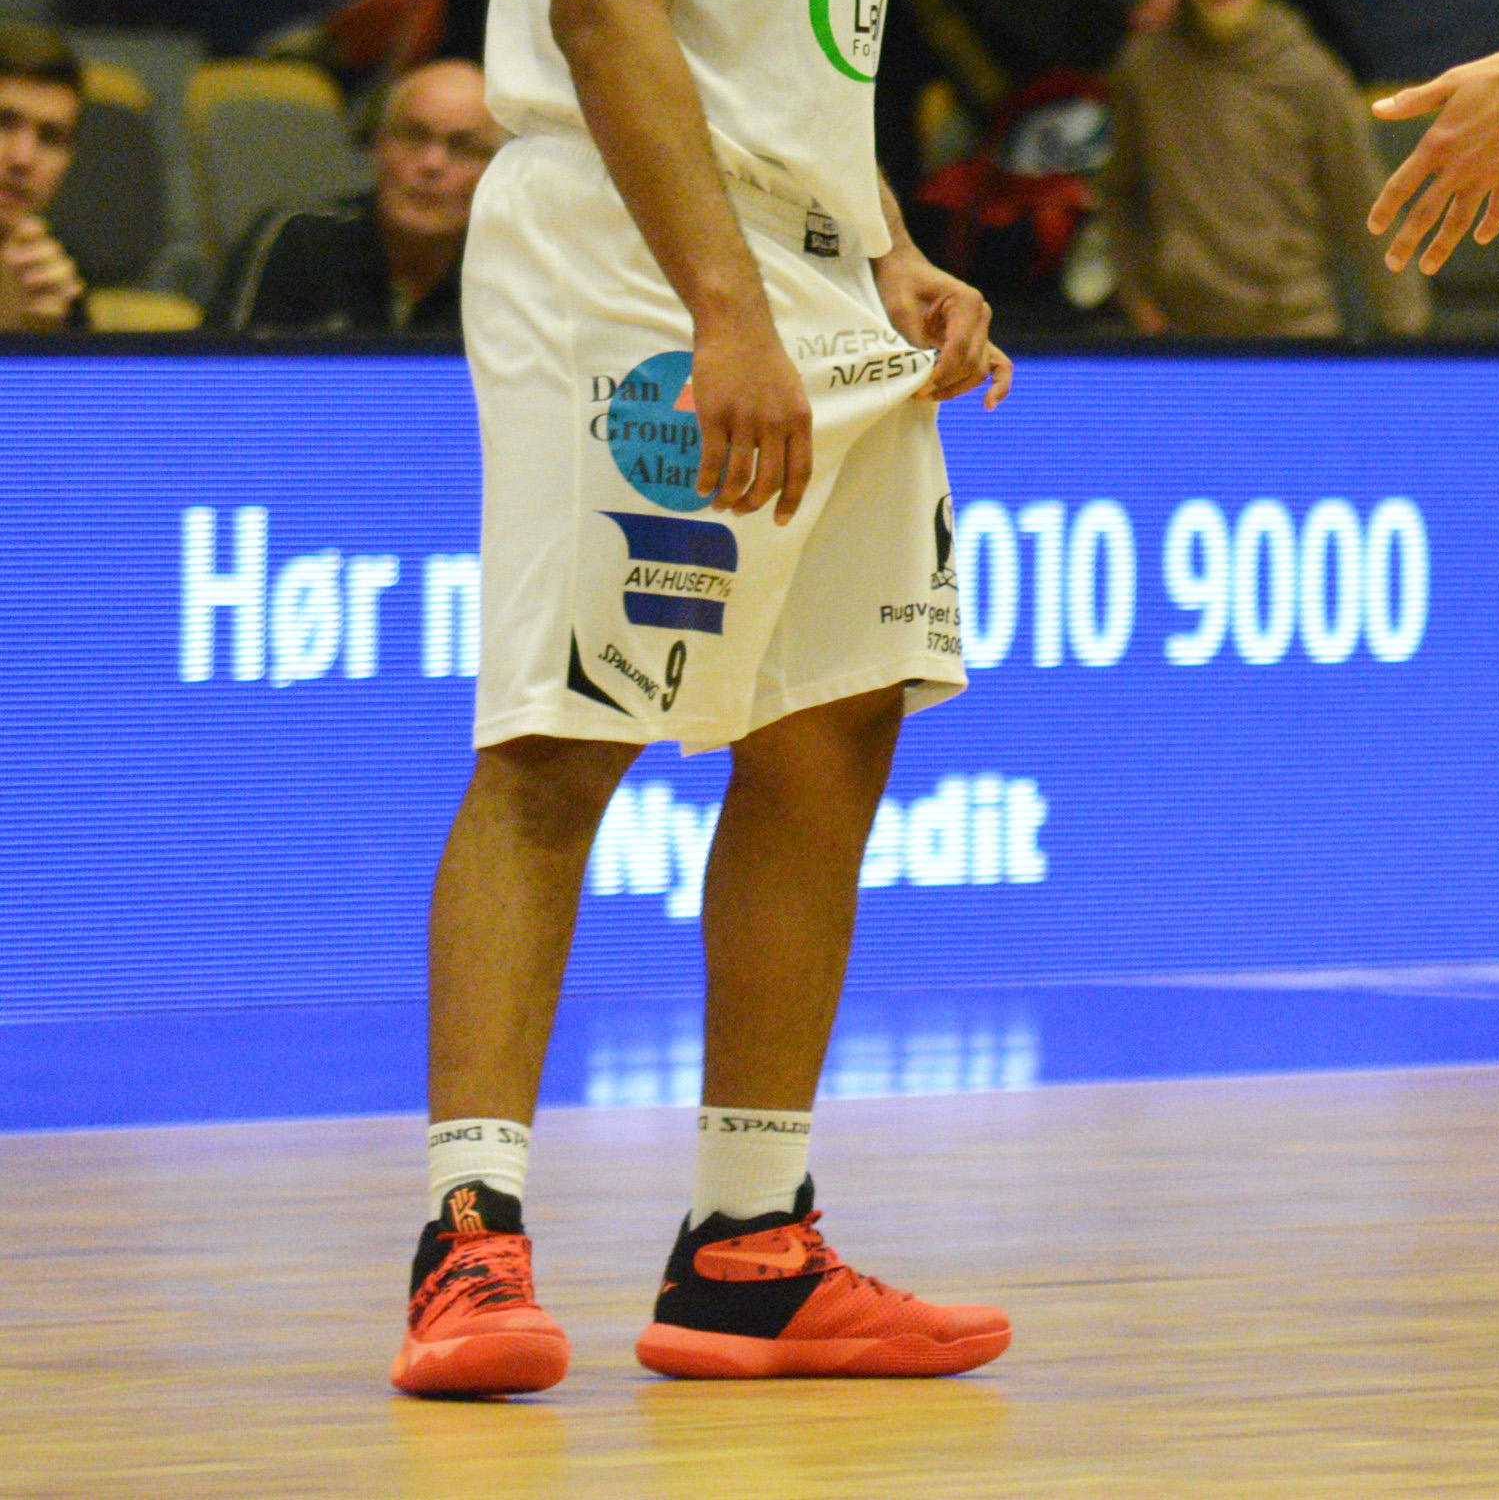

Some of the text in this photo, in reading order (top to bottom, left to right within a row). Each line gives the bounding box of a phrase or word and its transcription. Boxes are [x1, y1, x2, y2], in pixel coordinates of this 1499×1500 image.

[588, 374, 660, 404] Dan
[589, 411, 698, 455] Group
[626, 453, 698, 489] Alar
[183, 504, 398, 687] Hør
[955, 500, 1137, 668] 010
[1163, 498, 1432, 666] 9000
[660, 639, 687, 713] 9
